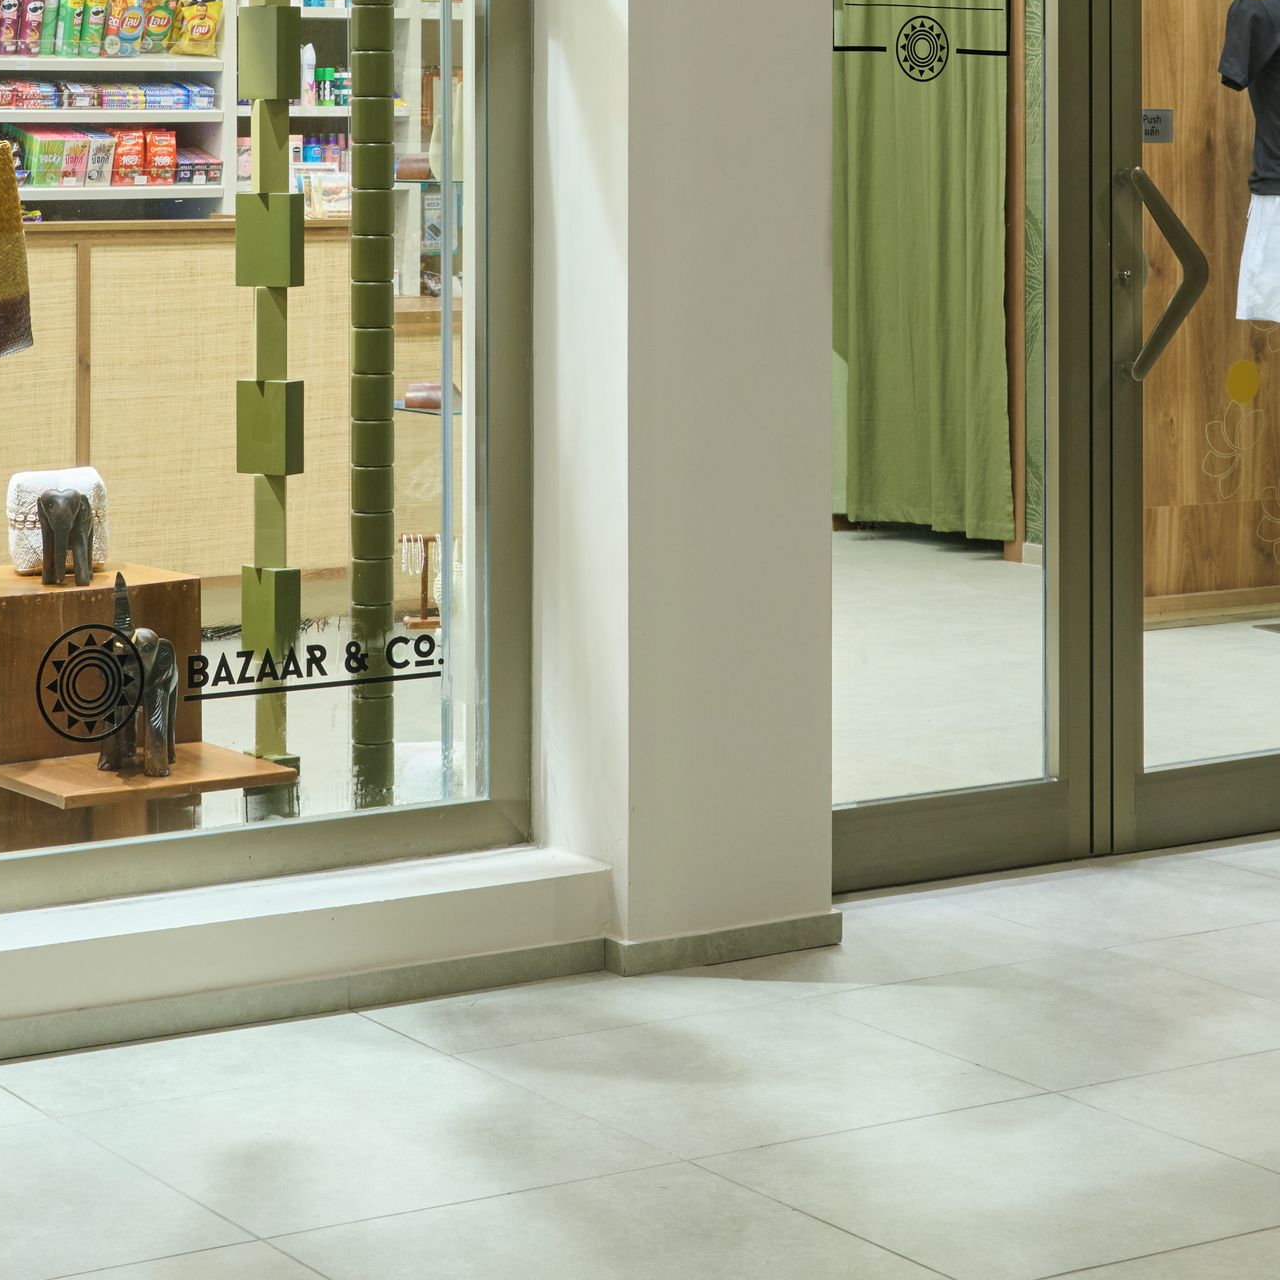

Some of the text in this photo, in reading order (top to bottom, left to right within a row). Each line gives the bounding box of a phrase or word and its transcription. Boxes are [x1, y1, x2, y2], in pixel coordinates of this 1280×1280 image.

[1143, 114, 1161, 124] Push
[187, 644, 328, 689] BAZAAR
[344, 640, 368, 674] &
